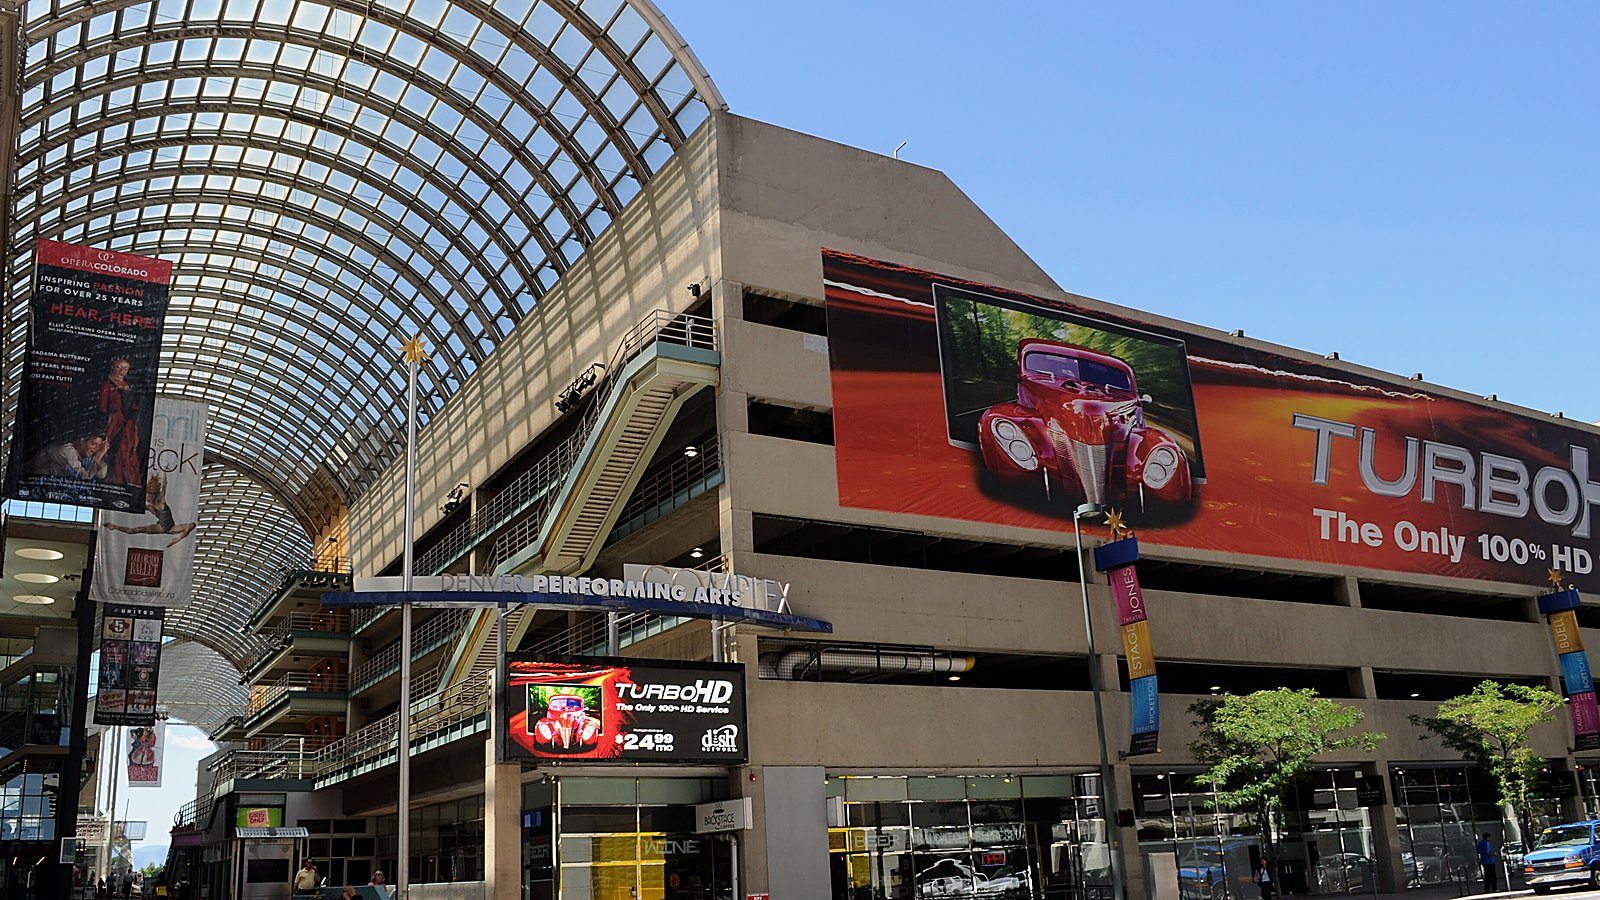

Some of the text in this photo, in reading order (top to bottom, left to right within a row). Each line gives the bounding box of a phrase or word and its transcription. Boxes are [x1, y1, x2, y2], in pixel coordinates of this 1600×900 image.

[40, 275, 145, 297] INSPIRING PASSION
[39, 284, 143, 307] FOR OVER 25 YEARS
[50, 303, 160, 329] HEAR, HERE!
[66, 324, 95, 334] CAULKINS
[96, 329, 116, 337] OPERA
[117, 332, 137, 340] HOUSE
[59, 353, 91, 362] BUTTERFLY
[154, 434, 166, 448] is
[1313, 507, 1593, 575] The Only 100% HD
[130, 562, 159, 577] BALLET
[441, 573, 523, 592] DENVER
[533, 574, 687, 601] PERFORMING
[694, 586, 742, 607] ARTS
[1122, 568, 1143, 613] JONES
[121, 608, 154, 616] UNITED
[1553, 616, 1570, 649] BUELL
[1125, 624, 1143, 670] STAGE
[616, 702, 634, 711] The
[635, 703, 656, 713] Only
[680, 705, 695, 713] HD
[696, 706, 730, 714] Service
[701, 725, 738, 747] dish
[655, 744, 674, 752] mo
[704, 813, 735, 826] BACKSTAGE
[644, 839, 700, 855] WINE
[853, 834, 900, 848] BEER
[529, 844, 551, 860] BEER
[983, 853, 1005, 865] OPEN
